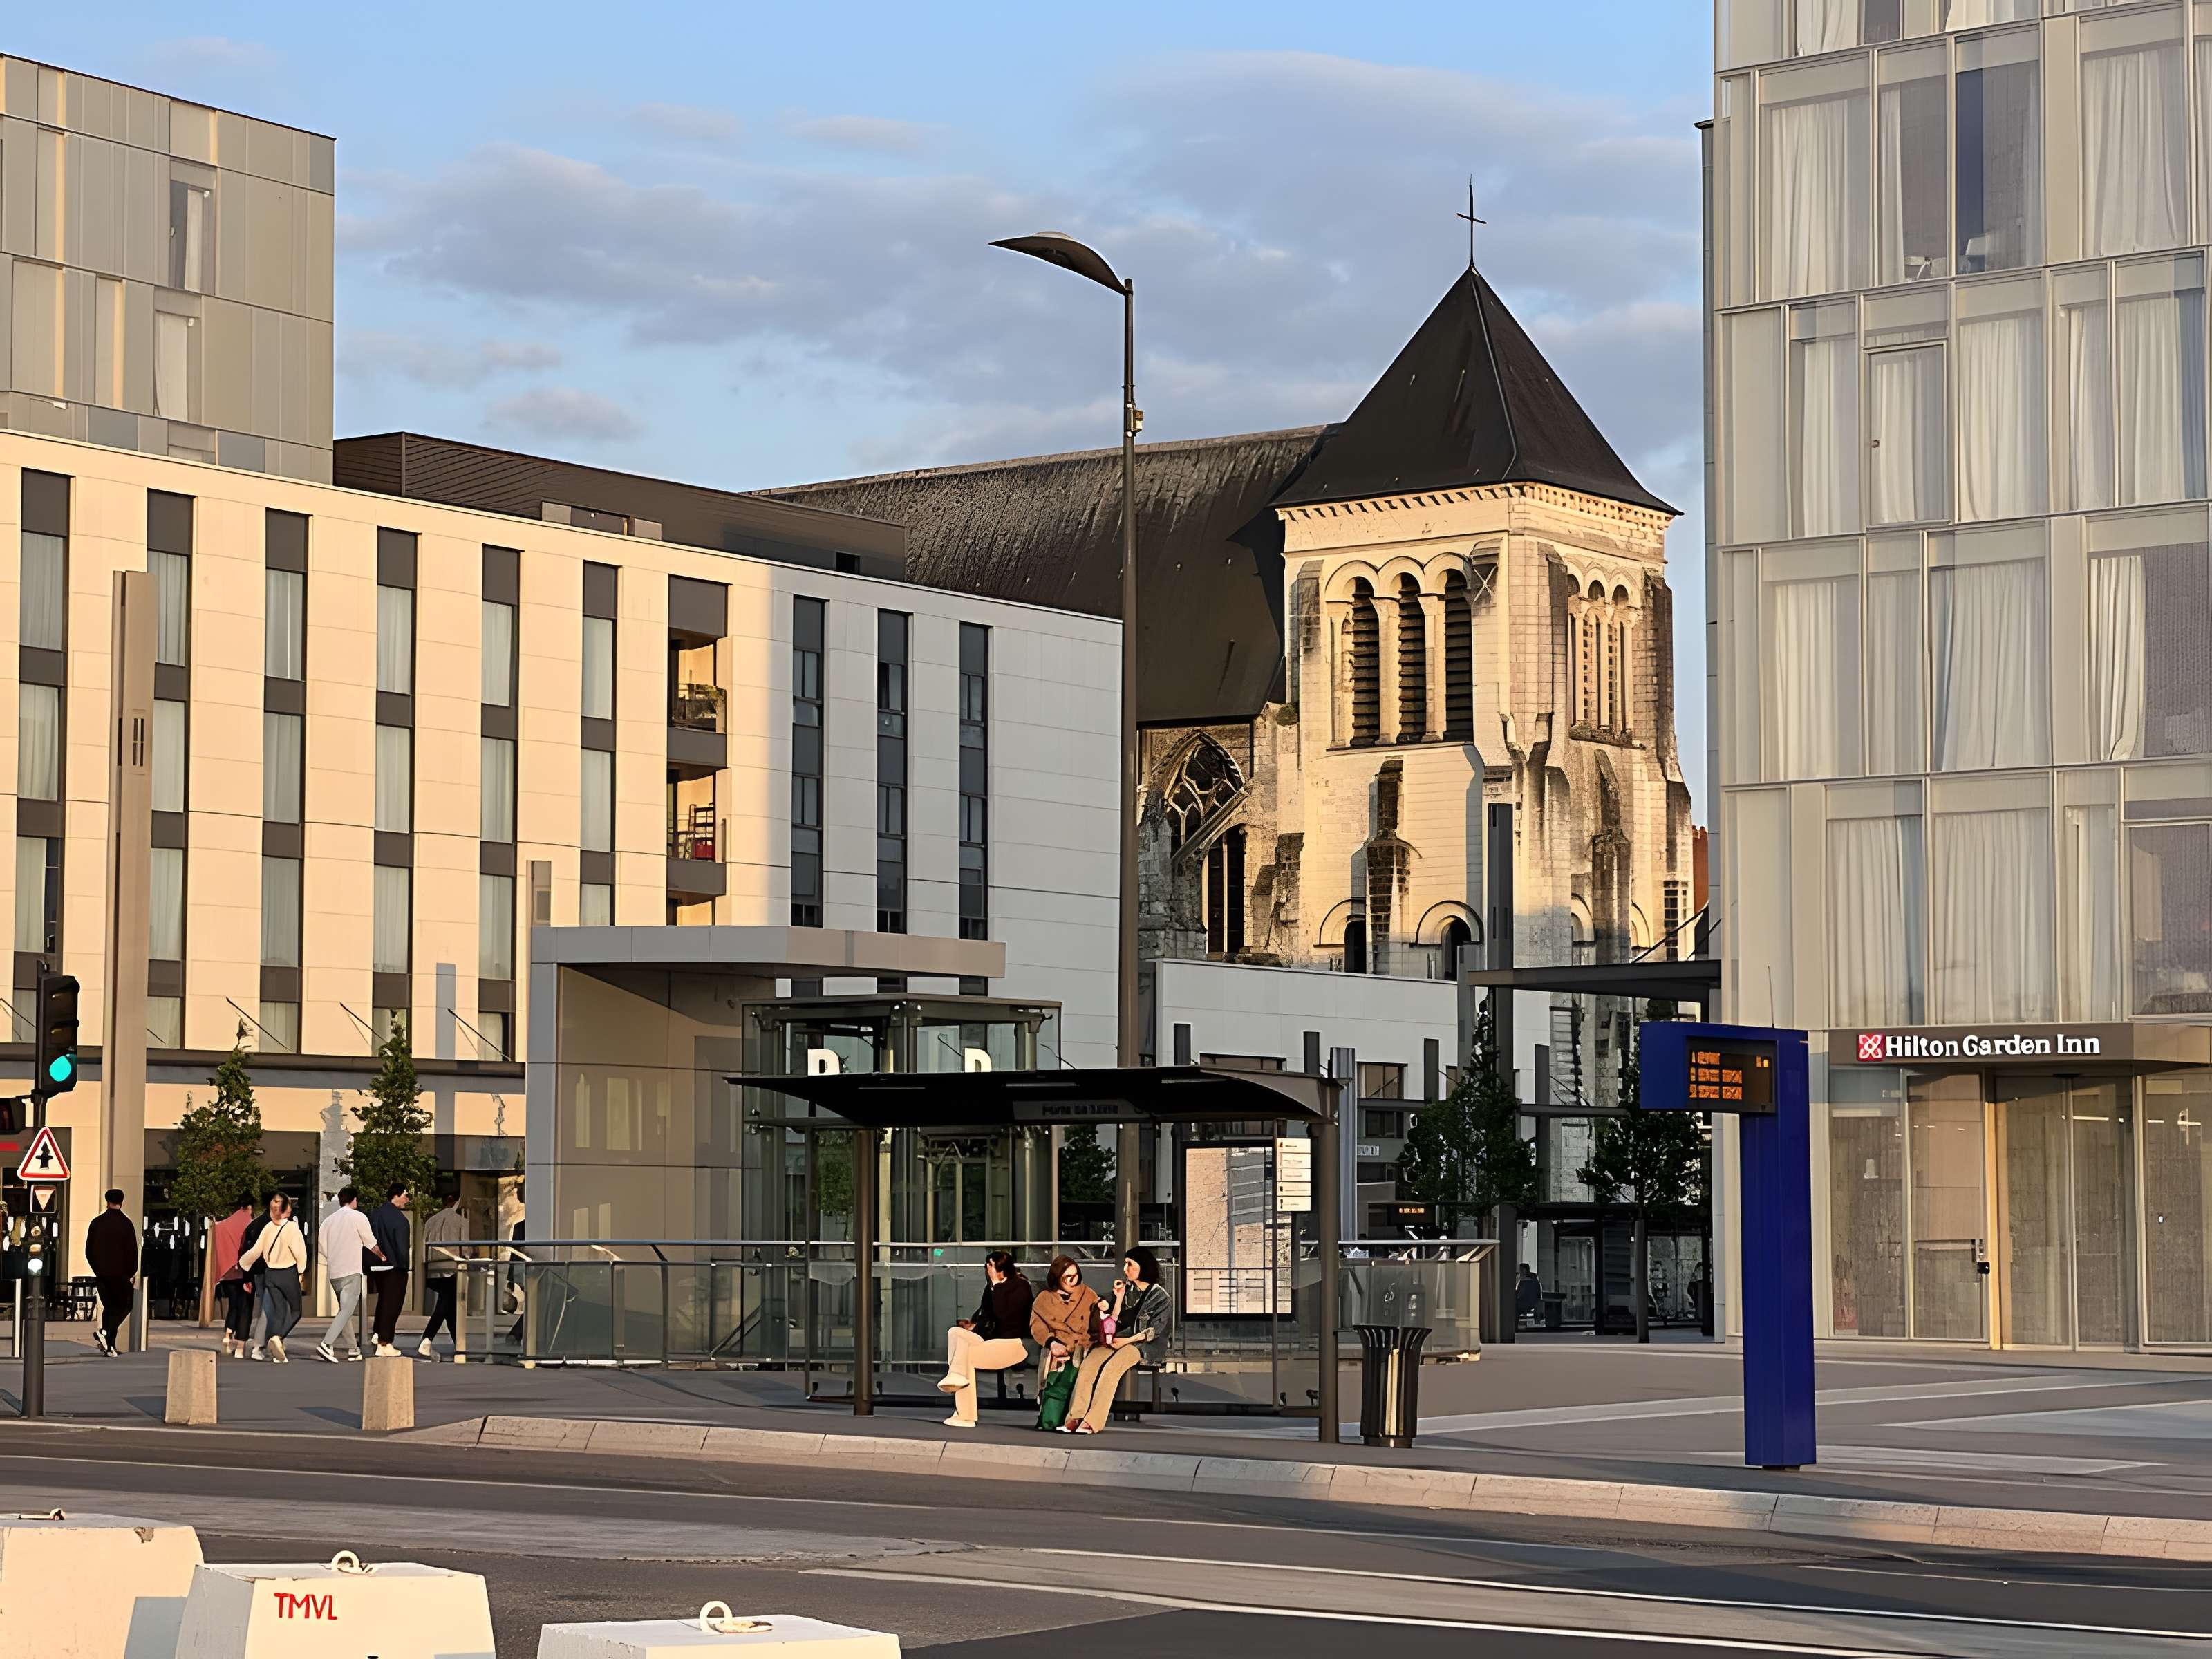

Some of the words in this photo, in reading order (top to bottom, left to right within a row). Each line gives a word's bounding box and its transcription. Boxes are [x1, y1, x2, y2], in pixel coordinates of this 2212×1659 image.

[1886, 1035, 1959, 1057] Hilton
[1962, 1034, 2051, 1056] Garden
[2056, 1034, 2101, 1054] Inn
[274, 1592, 338, 1620] TMVL
